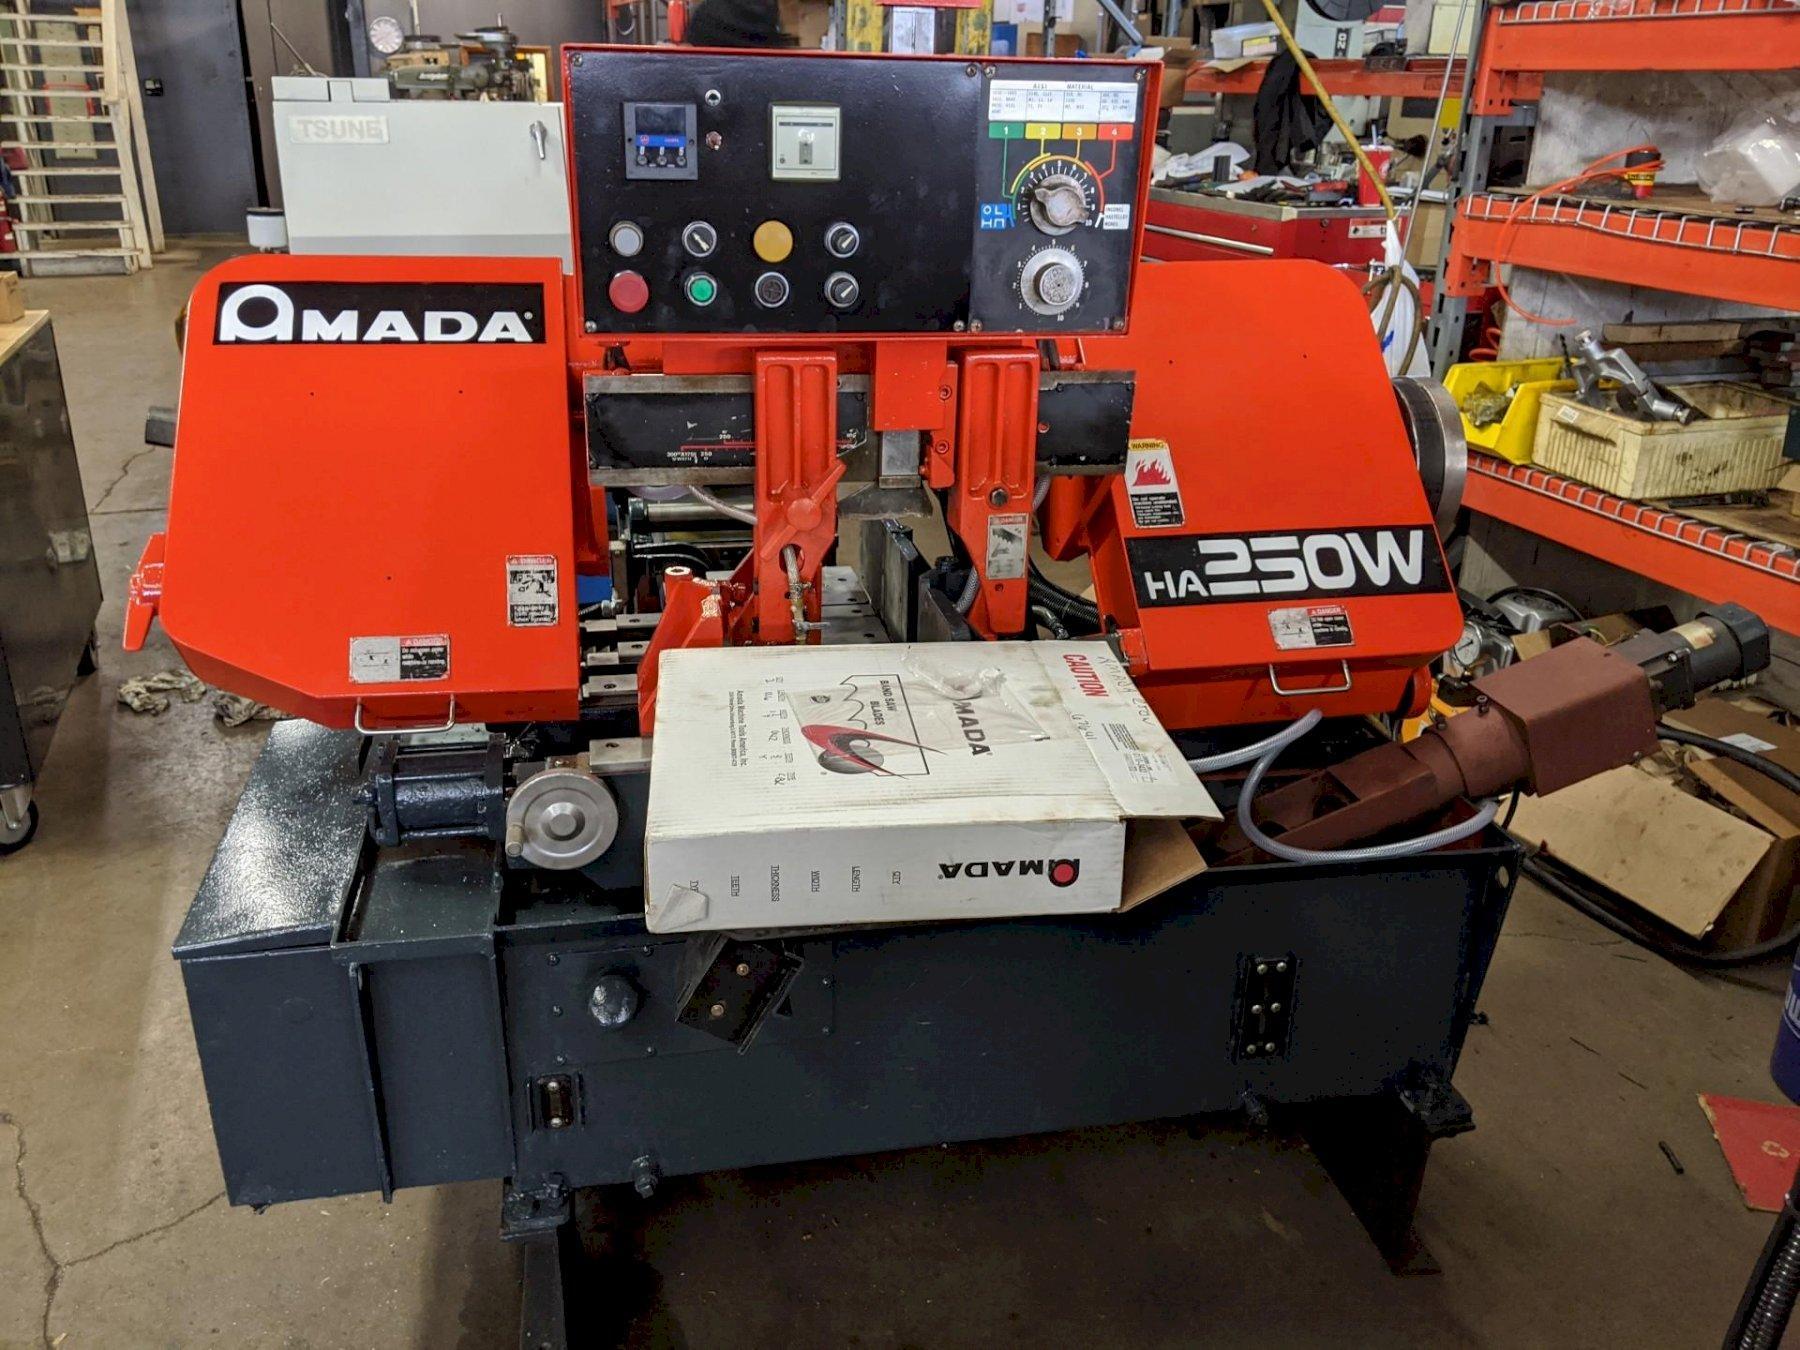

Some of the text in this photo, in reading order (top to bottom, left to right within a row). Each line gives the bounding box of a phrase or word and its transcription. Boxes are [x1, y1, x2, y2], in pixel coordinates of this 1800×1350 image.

[1004, 126, 1009, 135] 1
[1040, 127, 1047, 136] 2
[1076, 127, 1082, 136] 3
[1111, 128, 1118, 136] 4
[219, 284, 533, 342] AMADA
[1131, 441, 1165, 450] WARNING
[1063, 654, 1109, 697] CAUTION
[880, 680, 897, 712] BAND SAW
[870, 701, 885, 725] BLADES
[770, 864, 780, 902] THICKNESS
[811, 870, 820, 893] WIDTH
[851, 866, 861, 892] LENGTH
[891, 871, 901, 885] QTY
[938, 858, 1080, 887] AMADA
[730, 874, 740, 897] TEETH
